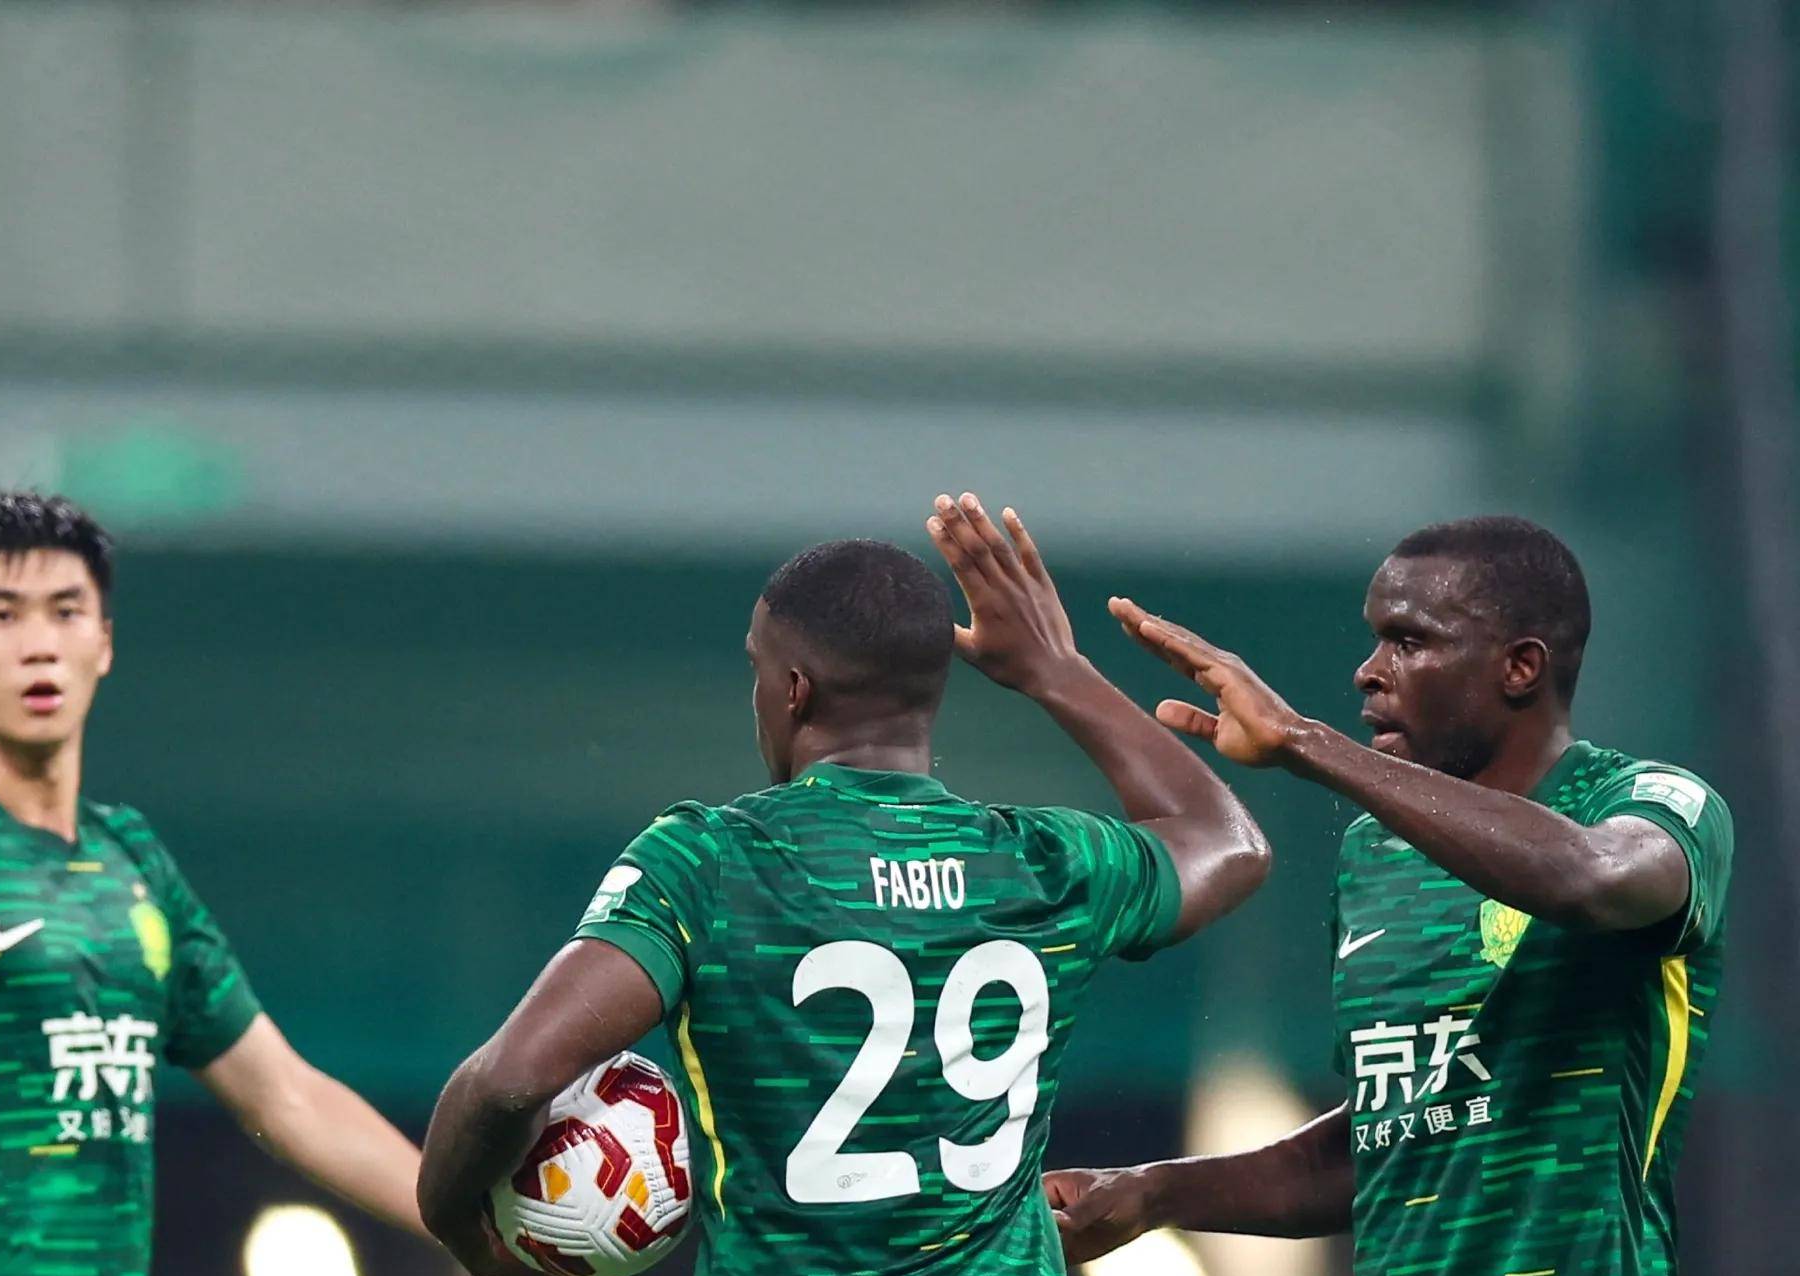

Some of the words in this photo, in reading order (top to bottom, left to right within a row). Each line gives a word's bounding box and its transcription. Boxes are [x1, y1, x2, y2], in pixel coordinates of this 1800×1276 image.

[869, 856, 965, 910] FABIO
[785, 939, 1050, 1203] 29
[1350, 1014, 1492, 1112] 京东
[1355, 1096, 1493, 1154] 又好又便宜
